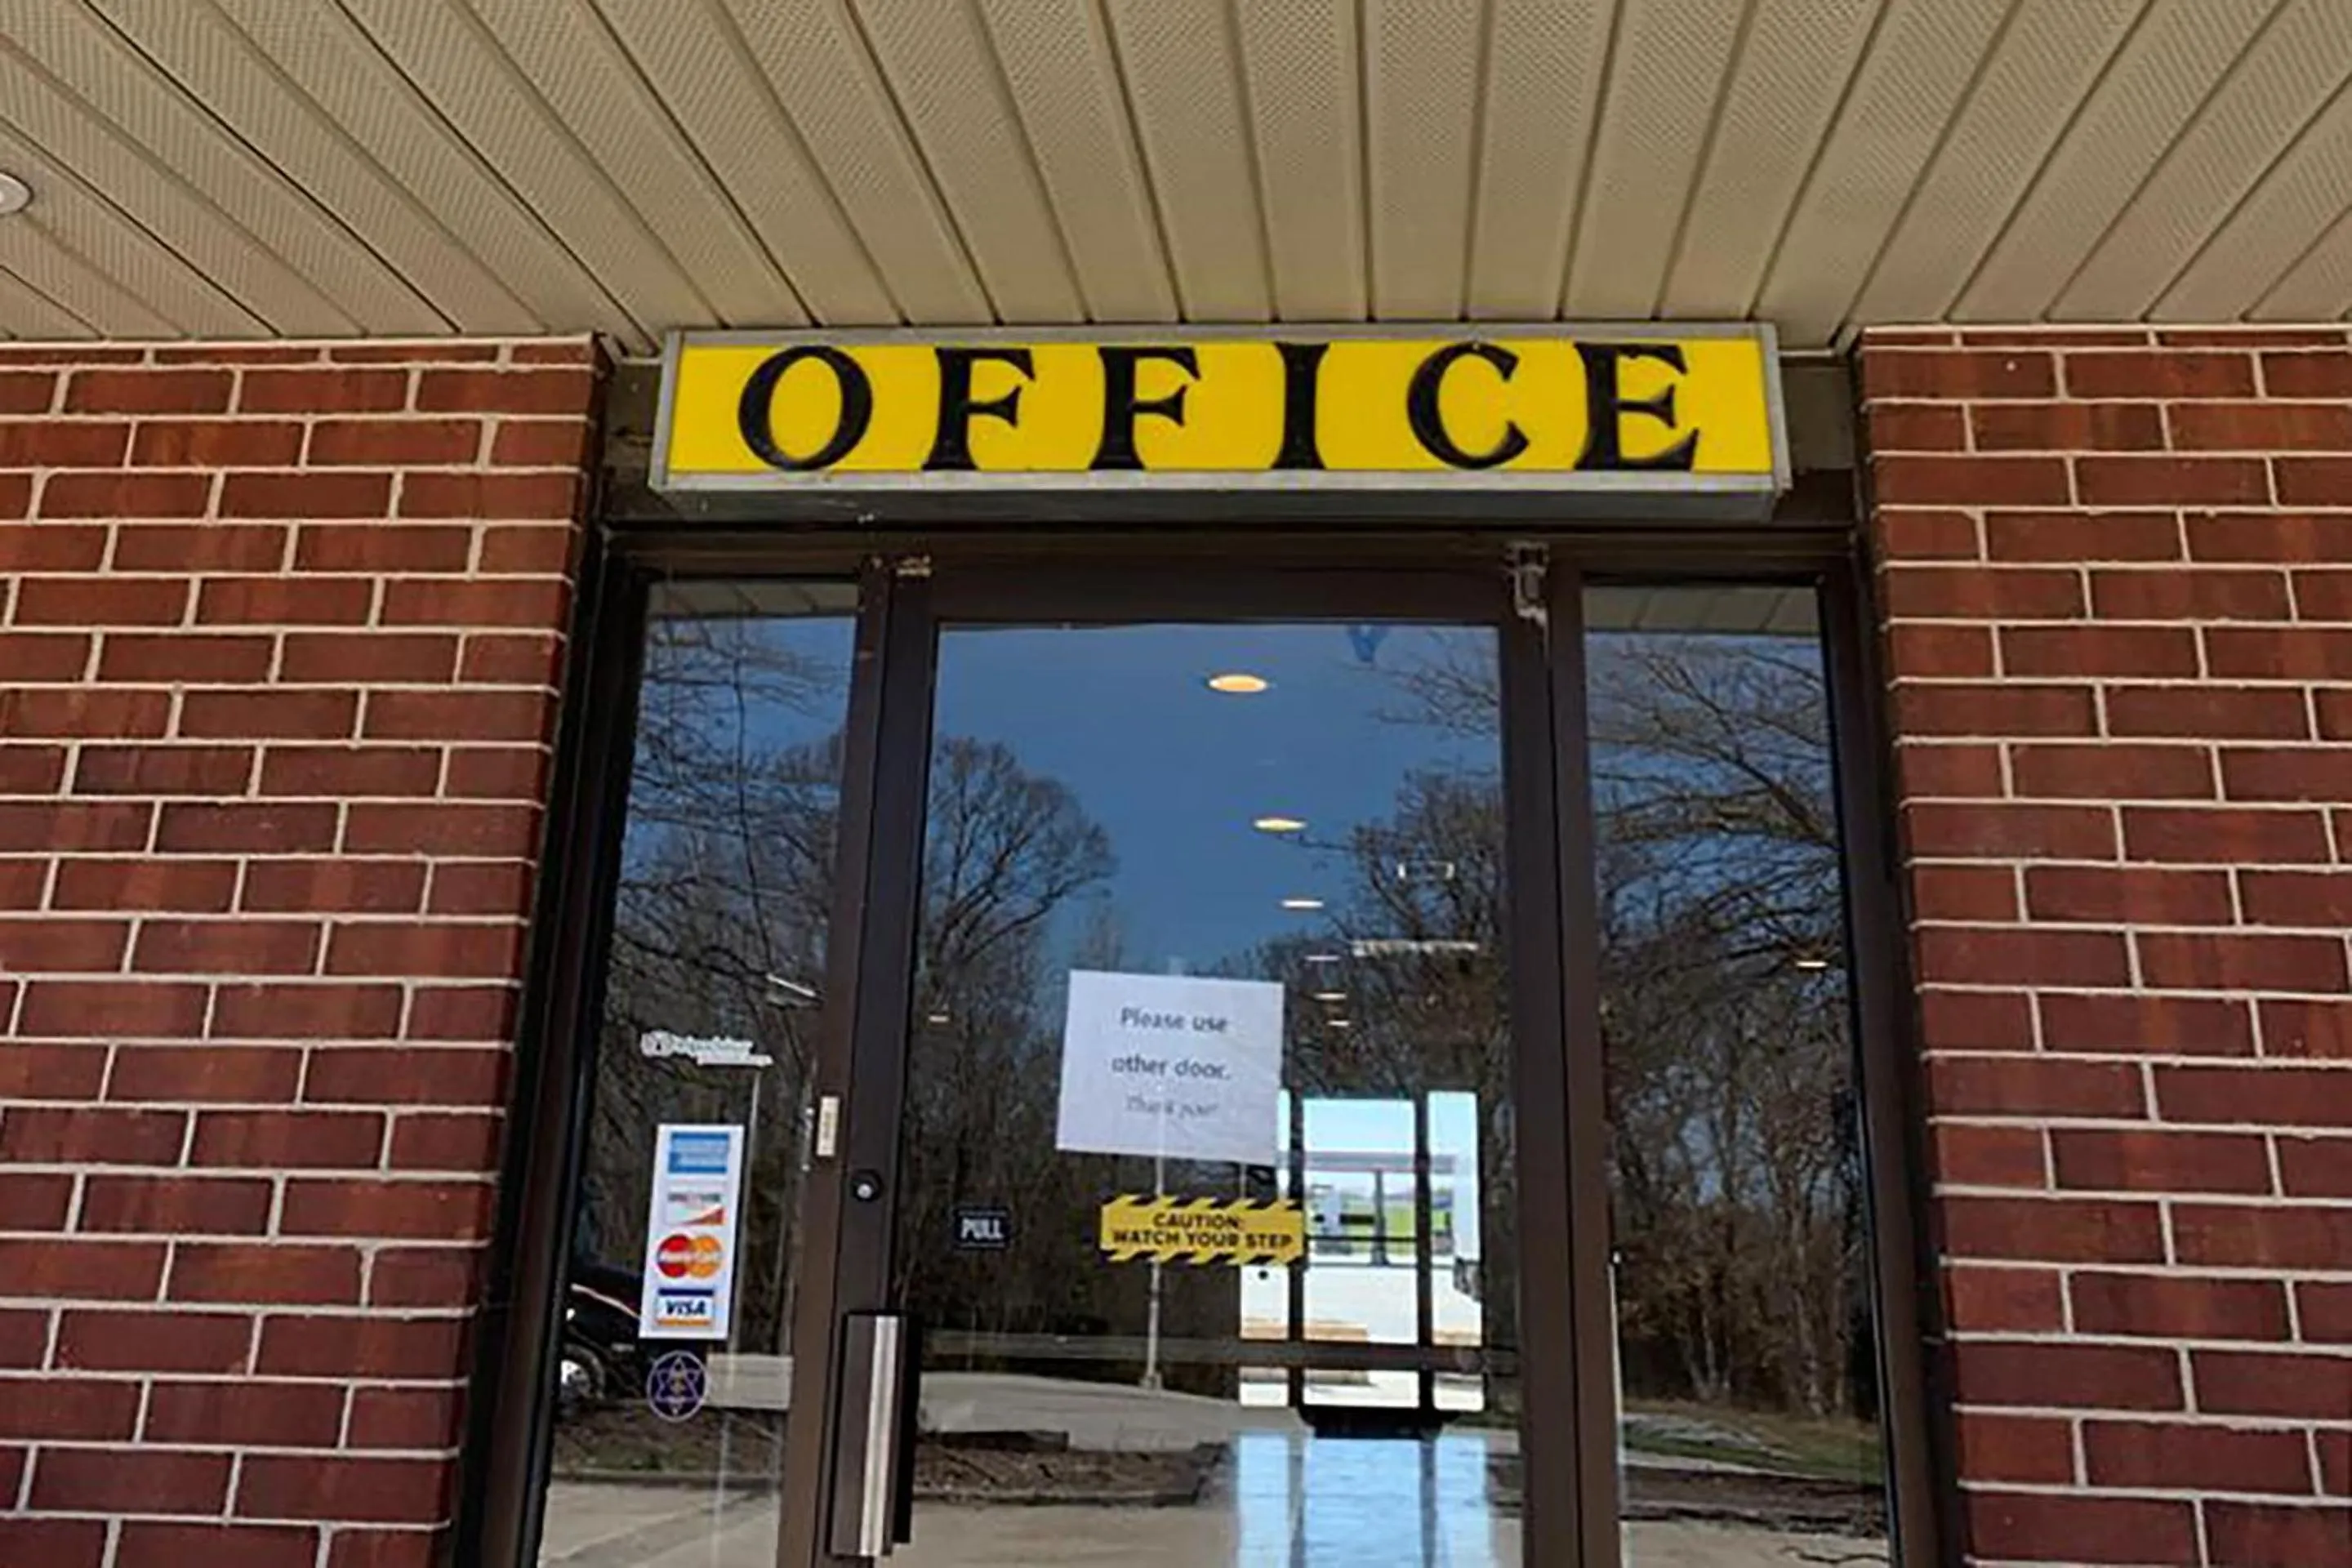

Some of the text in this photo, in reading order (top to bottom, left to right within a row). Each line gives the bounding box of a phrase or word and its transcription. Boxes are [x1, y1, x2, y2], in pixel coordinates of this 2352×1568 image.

[737, 341, 1699, 471] OFFICE
[1120, 1007, 1227, 1032] Please use
[1112, 1054, 1231, 1080] other door.
[961, 1218, 1004, 1239] PULL
[1112, 1229, 1293, 1249] WATCH YOUR STEP
[666, 1299, 706, 1315] VISA
